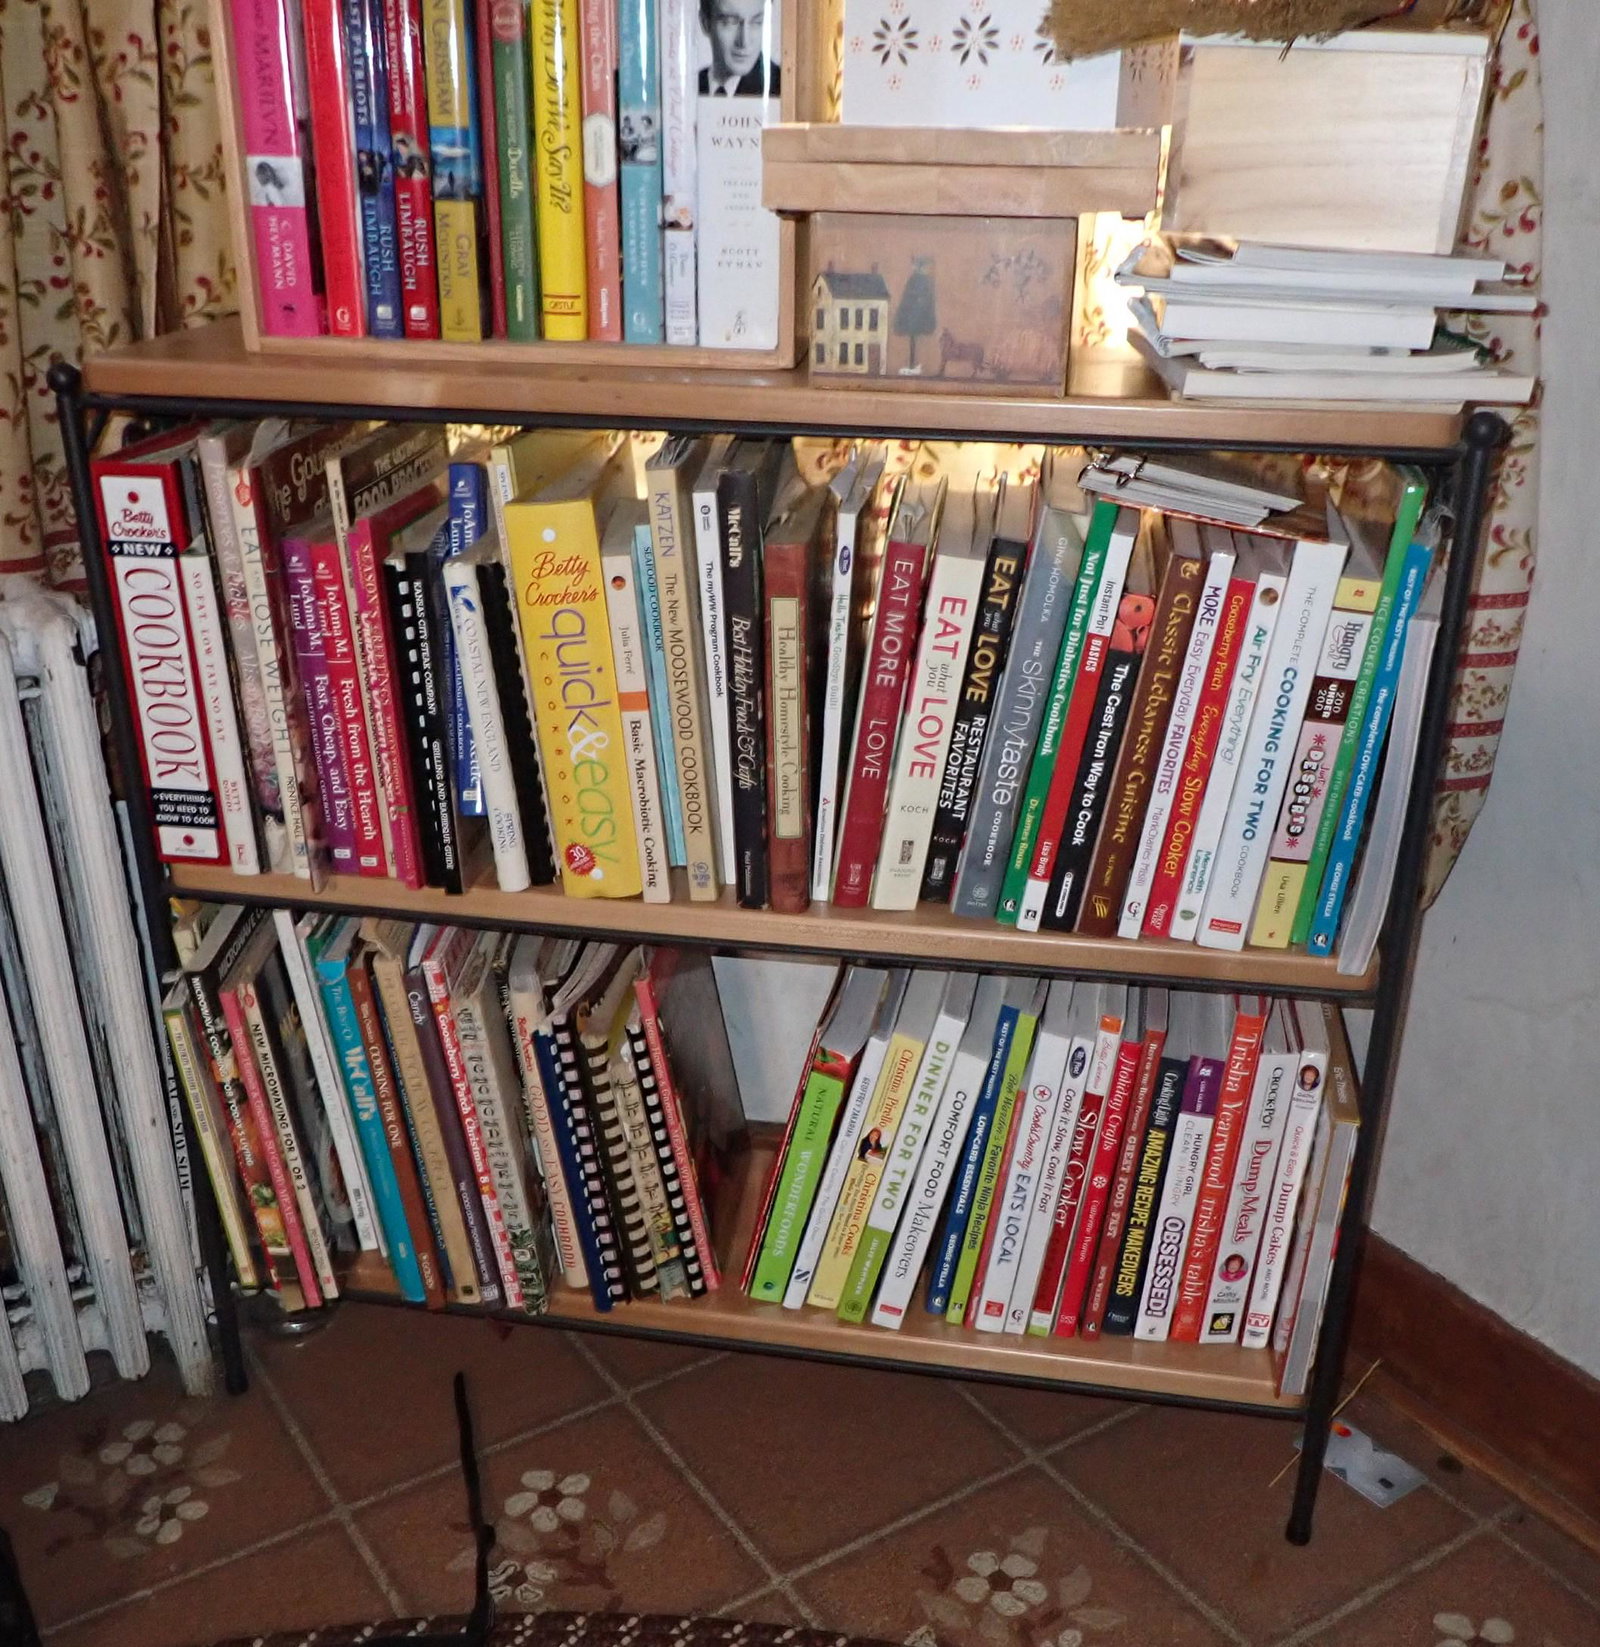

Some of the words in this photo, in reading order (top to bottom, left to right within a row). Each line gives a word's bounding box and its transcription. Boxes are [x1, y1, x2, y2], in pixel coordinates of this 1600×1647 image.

[353, 37, 369, 125] PATRIOTS
[431, 18, 453, 117] GRISHAM
[717, 115, 763, 128] JOHN
[363, 198, 382, 296] LIMBAUGH
[379, 223, 394, 271] RUSH
[399, 192, 417, 291] LIMBAUGH
[413, 218, 429, 267] RUSH
[435, 212, 453, 300] MOUNTAIN
[455, 233, 473, 278] GRAY
[281, 241, 297, 286] DAVID
[111, 523, 168, 541] Crocker's
[121, 507, 155, 528] Betty
[450, 519, 462, 557] Lund
[655, 491, 676, 558] KATZEN
[122, 543, 163, 558] NEW
[531, 551, 591, 586] Betty
[643, 545, 657, 594] SEAFOOD
[704, 560, 715, 579] The
[1083, 550, 1101, 575] Not
[524, 581, 600, 608] Crocker's
[664, 572, 678, 597] The
[705, 579, 718, 614] myWW
[889, 559, 914, 607] EAT
[986, 556, 1017, 611] EAT
[1077, 576, 1094, 605] Just
[1098, 580, 1117, 613] Instant
[1303, 586, 1318, 606] THE
[1402, 589, 1413, 601] OF
[1407, 567, 1418, 588] BEST
[290, 593, 305, 630] Lund
[413, 581, 425, 618] KANSAS
[666, 599, 680, 626] New
[1071, 607, 1087, 632] for
[1397, 601, 1410, 618] THE
[418, 619, 428, 640] CITY
[648, 594, 664, 653] COOKBOOK
[707, 613, 720, 653] Program
[931, 595, 968, 660] EAT
[1095, 614, 1109, 631] Pot
[1157, 592, 1192, 666] Classic
[1216, 594, 1244, 660] Gooseberry
[1289, 608, 1311, 665] COMPLETE
[1393, 618, 1405, 638] BEST
[420, 640, 432, 671] STEAK
[540, 606, 612, 732] quick
[774, 625, 796, 682] Healthy
[875, 611, 906, 688] MORE
[965, 633, 999, 703] LOVE
[1032, 640, 1043, 658] THE
[1055, 631, 1081, 691] Diabetics
[1085, 638, 1103, 673] BASICS
[123, 567, 202, 784] COOKBOOK
[424, 671, 437, 716] COMPANY
[668, 628, 694, 741] MOOSEWOOD
[713, 653, 726, 698] Cookbook
[925, 659, 939, 688] you
[936, 662, 952, 694] what
[1110, 663, 1131, 692] The
[1210, 660, 1228, 691] Patch
[1376, 686, 1390, 704] the
[341, 677, 358, 719] Fresh
[1100, 694, 1122, 728] Cast
[1131, 671, 1172, 765] Lebanese
[1264, 666, 1299, 754] COOKING
[1314, 688, 1327, 712] 200
[1321, 683, 1338, 719] UNDER
[1332, 691, 1346, 714] 200
[347, 723, 362, 758] from
[629, 719, 643, 754] Basic
[776, 686, 799, 758] Homestyle
[908, 697, 949, 779] LOVE
[991, 659, 1046, 806] Skinnytaste
[1041, 693, 1066, 757] Cookbook
[1184, 705, 1220, 773] Everyday
[1364, 705, 1386, 749] complete
[432, 740, 443, 781] GRILLING
[566, 722, 610, 767] &
[862, 719, 888, 780] LOVE
[938, 722, 969, 809] FAVORITES
[1093, 730, 1112, 759] Iron
[354, 763, 368, 786] the
[779, 761, 799, 816] Cooking
[951, 715, 986, 821] RESTAURANT
[1083, 761, 1104, 791] Way
[1252, 757, 1275, 795] FOR
[1352, 749, 1374, 798] LOW-CARB
[436, 781, 447, 801] AND
[570, 758, 620, 865] easy
[634, 757, 653, 834] Macrobiotic
[680, 746, 702, 835] COOKBOOK
[900, 804, 929, 814] KOCH
[1027, 798, 1039, 812] Dr.
[1081, 792, 1096, 808] to
[1111, 770, 1146, 845] Cuisine
[1178, 775, 1202, 816] Slow
[357, 790, 378, 841] Hearth
[439, 802, 451, 845] BARBEQUE
[1020, 813, 1035, 841] James
[1071, 809, 1092, 846] Cook
[1242, 799, 1265, 842] TWO
[1342, 798, 1361, 842] cookbook
[444, 845, 455, 870] GUIDE
[982, 810, 1003, 867] COOKBOOK
[1014, 842, 1029, 870] Rouse
[1163, 819, 1191, 878] Cooker
[643, 837, 659, 889] Cooking
[1230, 844, 1250, 899] COOKBOOK
[1329, 861, 1344, 892] GEORGE
[1322, 892, 1338, 918] STELLA
[407, 990, 426, 1025] Candy
[191, 976, 215, 1034] MICROWAVE
[209, 1035, 227, 1077] COOKING
[222, 1079, 233, 1097] FOR
[228, 1099, 247, 1137] TODAY'S
[239, 1137, 254, 1167] LIVING
[368, 1045, 391, 1098] COOKING
[912, 1040, 950, 1116] DINNER
[1225, 1033, 1258, 1093] Trisha
[251, 1023, 265, 1049] NEW
[259, 1052, 289, 1130] MICROWAVING
[283, 1133, 295, 1153] FOR
[291, 1166, 303, 1180] OR
[382, 1101, 397, 1124] FOR
[438, 1013, 460, 1080] Gooseberry
[455, 1082, 472, 1116] Patch
[464, 1117, 483, 1174] Christmas
[1060, 1088, 1077, 1113] Cook
[387, 1123, 402, 1149] ONE
[936, 1089, 967, 1159] COMFORT
[1051, 1125, 1068, 1153] Slow,
[1059, 1114, 1070, 1125] it
[1071, 1108, 1098, 1156] Slow
[897, 1121, 921, 1162] FOR
[1142, 1128, 1167, 1184] AMAZING
[1187, 1132, 1204, 1174] HUNGRY
[1205, 1101, 1243, 1190] Yearwood
[923, 1159, 945, 1199] FOOD
[1043, 1182, 1055, 1192] it
[1044, 1155, 1061, 1180] Cook
[1182, 1175, 1194, 1198] GIRL
[1243, 1139, 1273, 1193] Dump
[851, 1172, 877, 1222] Christina
[881, 1168, 907, 1211] TWO
[1010, 1172, 1031, 1212] EATS
[1037, 1192, 1052, 1214] Fast
[1054, 1160, 1086, 1229] Cooker
[1130, 1185, 1156, 1228] RECIPE
[841, 1222, 860, 1257] Cooks
[894, 1200, 934, 1281] Makeovers
[996, 1215, 1020, 1266] LOCAL
[1233, 1195, 1260, 1244] Meals
[1114, 1227, 1145, 1297] MAKEOVERS
[1145, 1216, 1186, 1318] OBSESSED!
